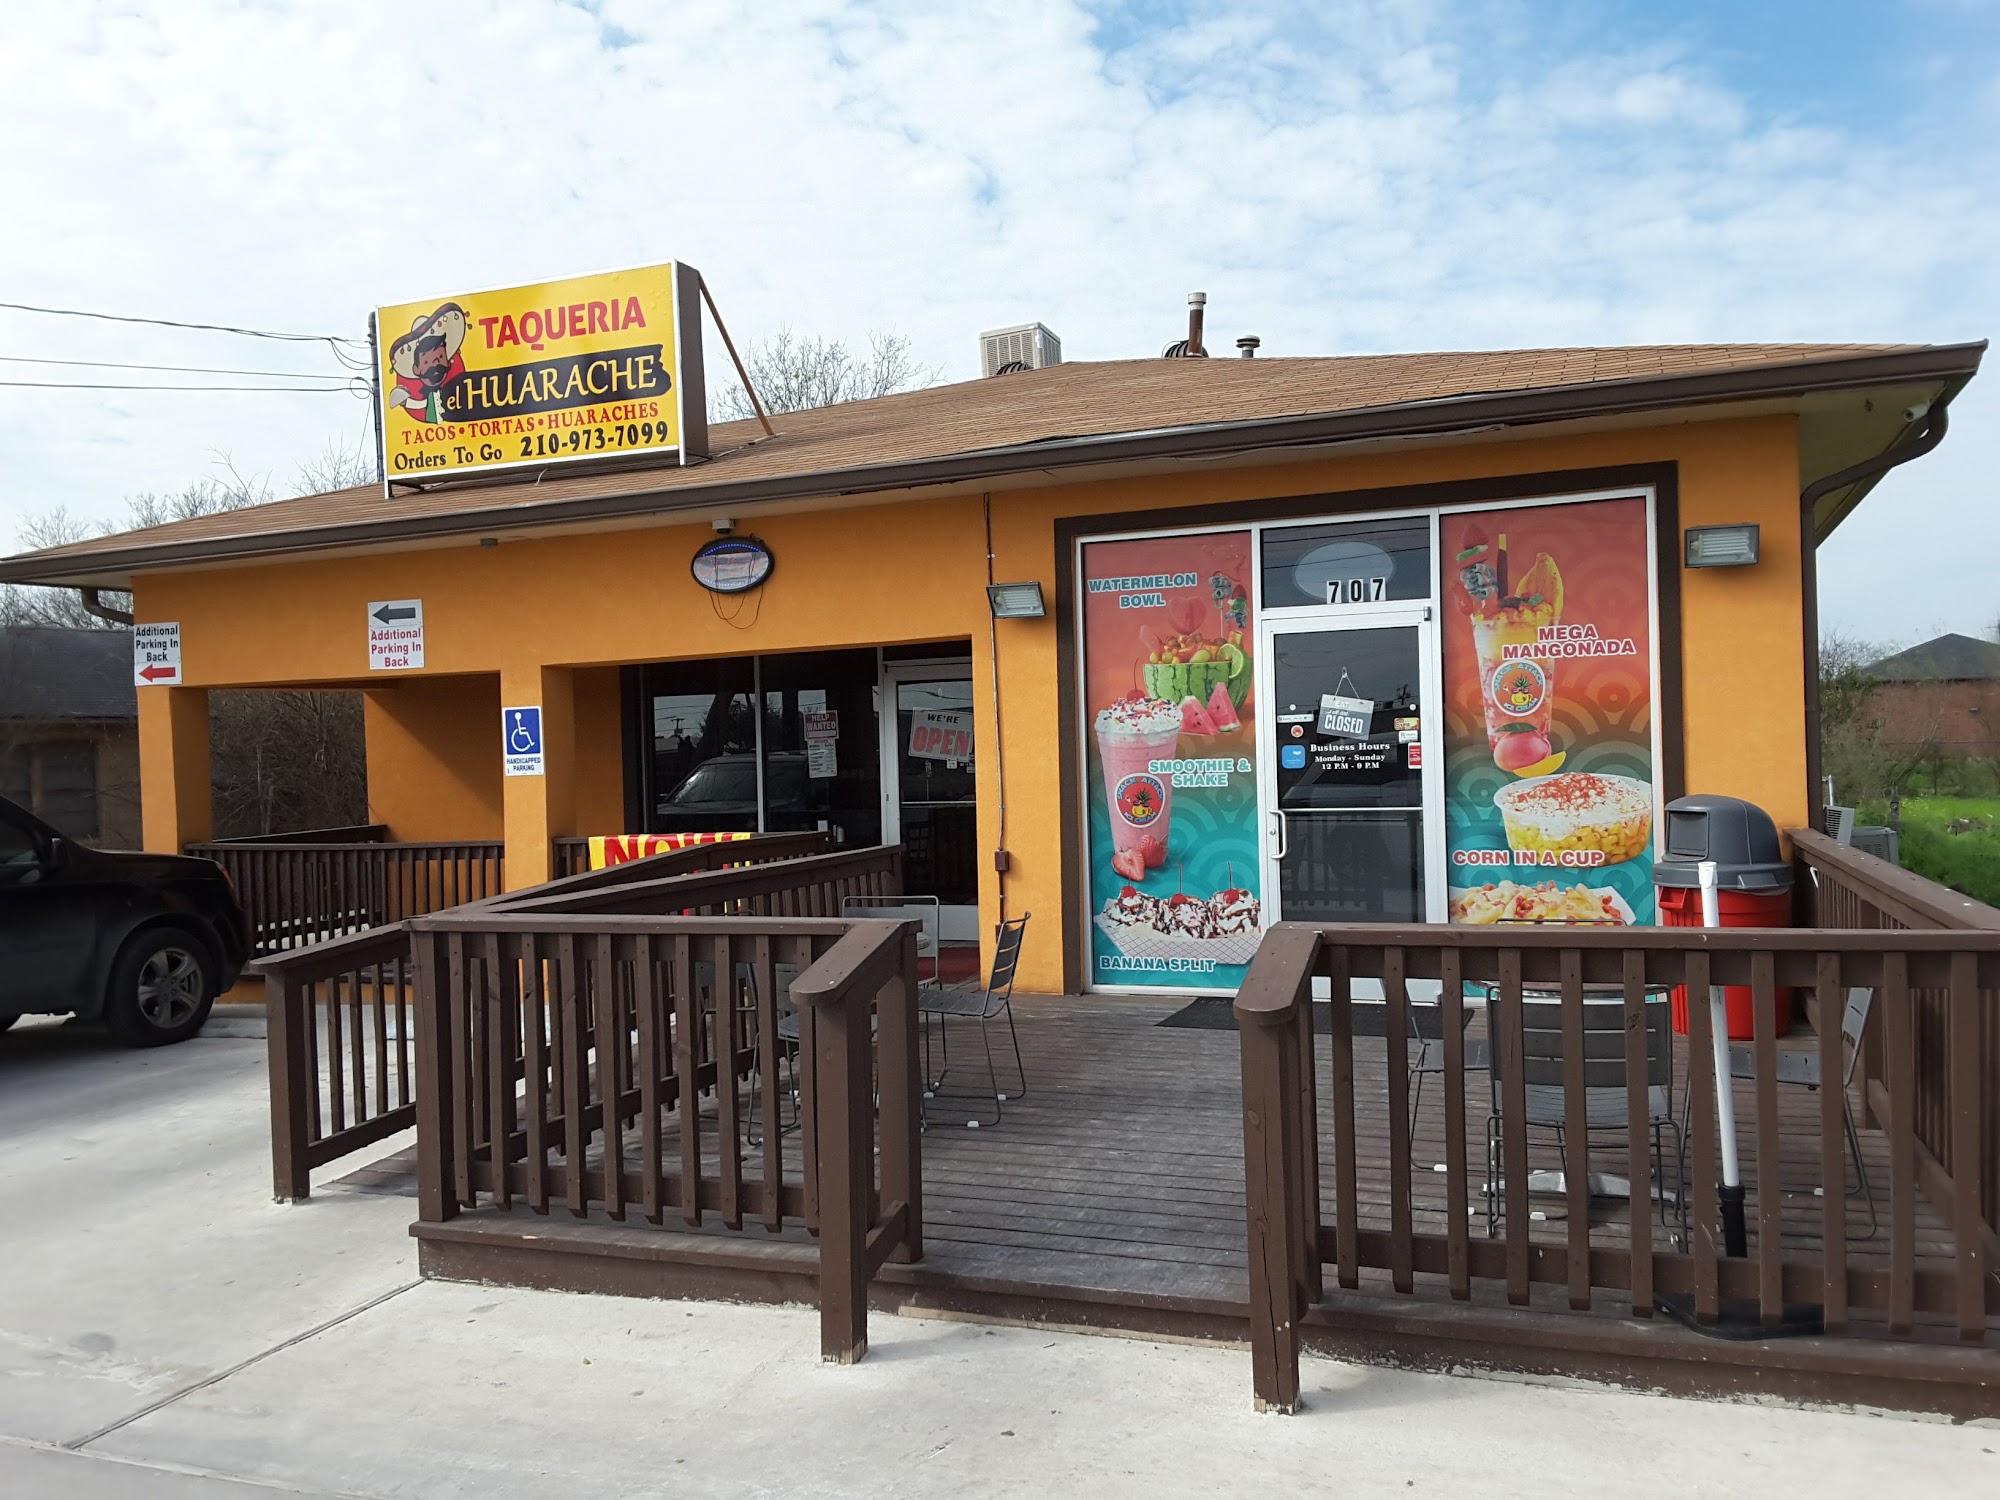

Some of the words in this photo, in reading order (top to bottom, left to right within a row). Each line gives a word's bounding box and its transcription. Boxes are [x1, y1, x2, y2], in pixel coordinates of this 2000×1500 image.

[478, 296, 646, 351] TAQUERIA
[446, 385, 463, 410] el
[464, 354, 657, 410] HUARACHE
[402, 425, 456, 445] TACOS
[468, 417, 535, 437] TORTAS
[547, 402, 658, 429] HUARACHES
[394, 450, 446, 470] Orders
[453, 446, 474, 464] To
[480, 443, 502, 461] Go
[520, 420, 668, 457] 210-973-7099
[1088, 573, 1197, 592] WATERMELON
[1329, 579, 1383, 603] 707
[1119, 593, 1166, 609] BOWL
[136, 625, 178, 637] Additional
[371, 628, 421, 641] Additional
[1538, 624, 1598, 642] MEGA
[136, 639, 167, 651] Parking
[170, 638, 179, 648] In
[371, 643, 409, 655] Parking
[412, 641, 422, 652] In
[1502, 638, 1636, 660] MANGONADA
[146, 651, 168, 662] Back
[384, 656, 409, 667] Back
[811, 714, 830, 722] HELP
[927, 713, 960, 724] WE'RE
[1324, 714, 1364, 734] CLOSED
[806, 721, 836, 731] WANTED
[912, 725, 970, 757] OPEN
[1310, 744, 1355, 752] Business
[507, 757, 541, 765] HANDICAPPED
[1149, 758, 1234, 773] SMOOTHIE
[1237, 758, 1251, 772] &
[1314, 755, 1346, 763] Monday
[1354, 754, 1386, 762] Sunday
[1171, 773, 1228, 788] SHAKE
[1453, 850, 1510, 866] CORN
[1514, 850, 1538, 866] IN
[1541, 850, 1557, 866] A
[1561, 850, 1605, 866] CUP
[1100, 956, 1167, 971] BANANA
[1169, 957, 1216, 972] SPLIT
